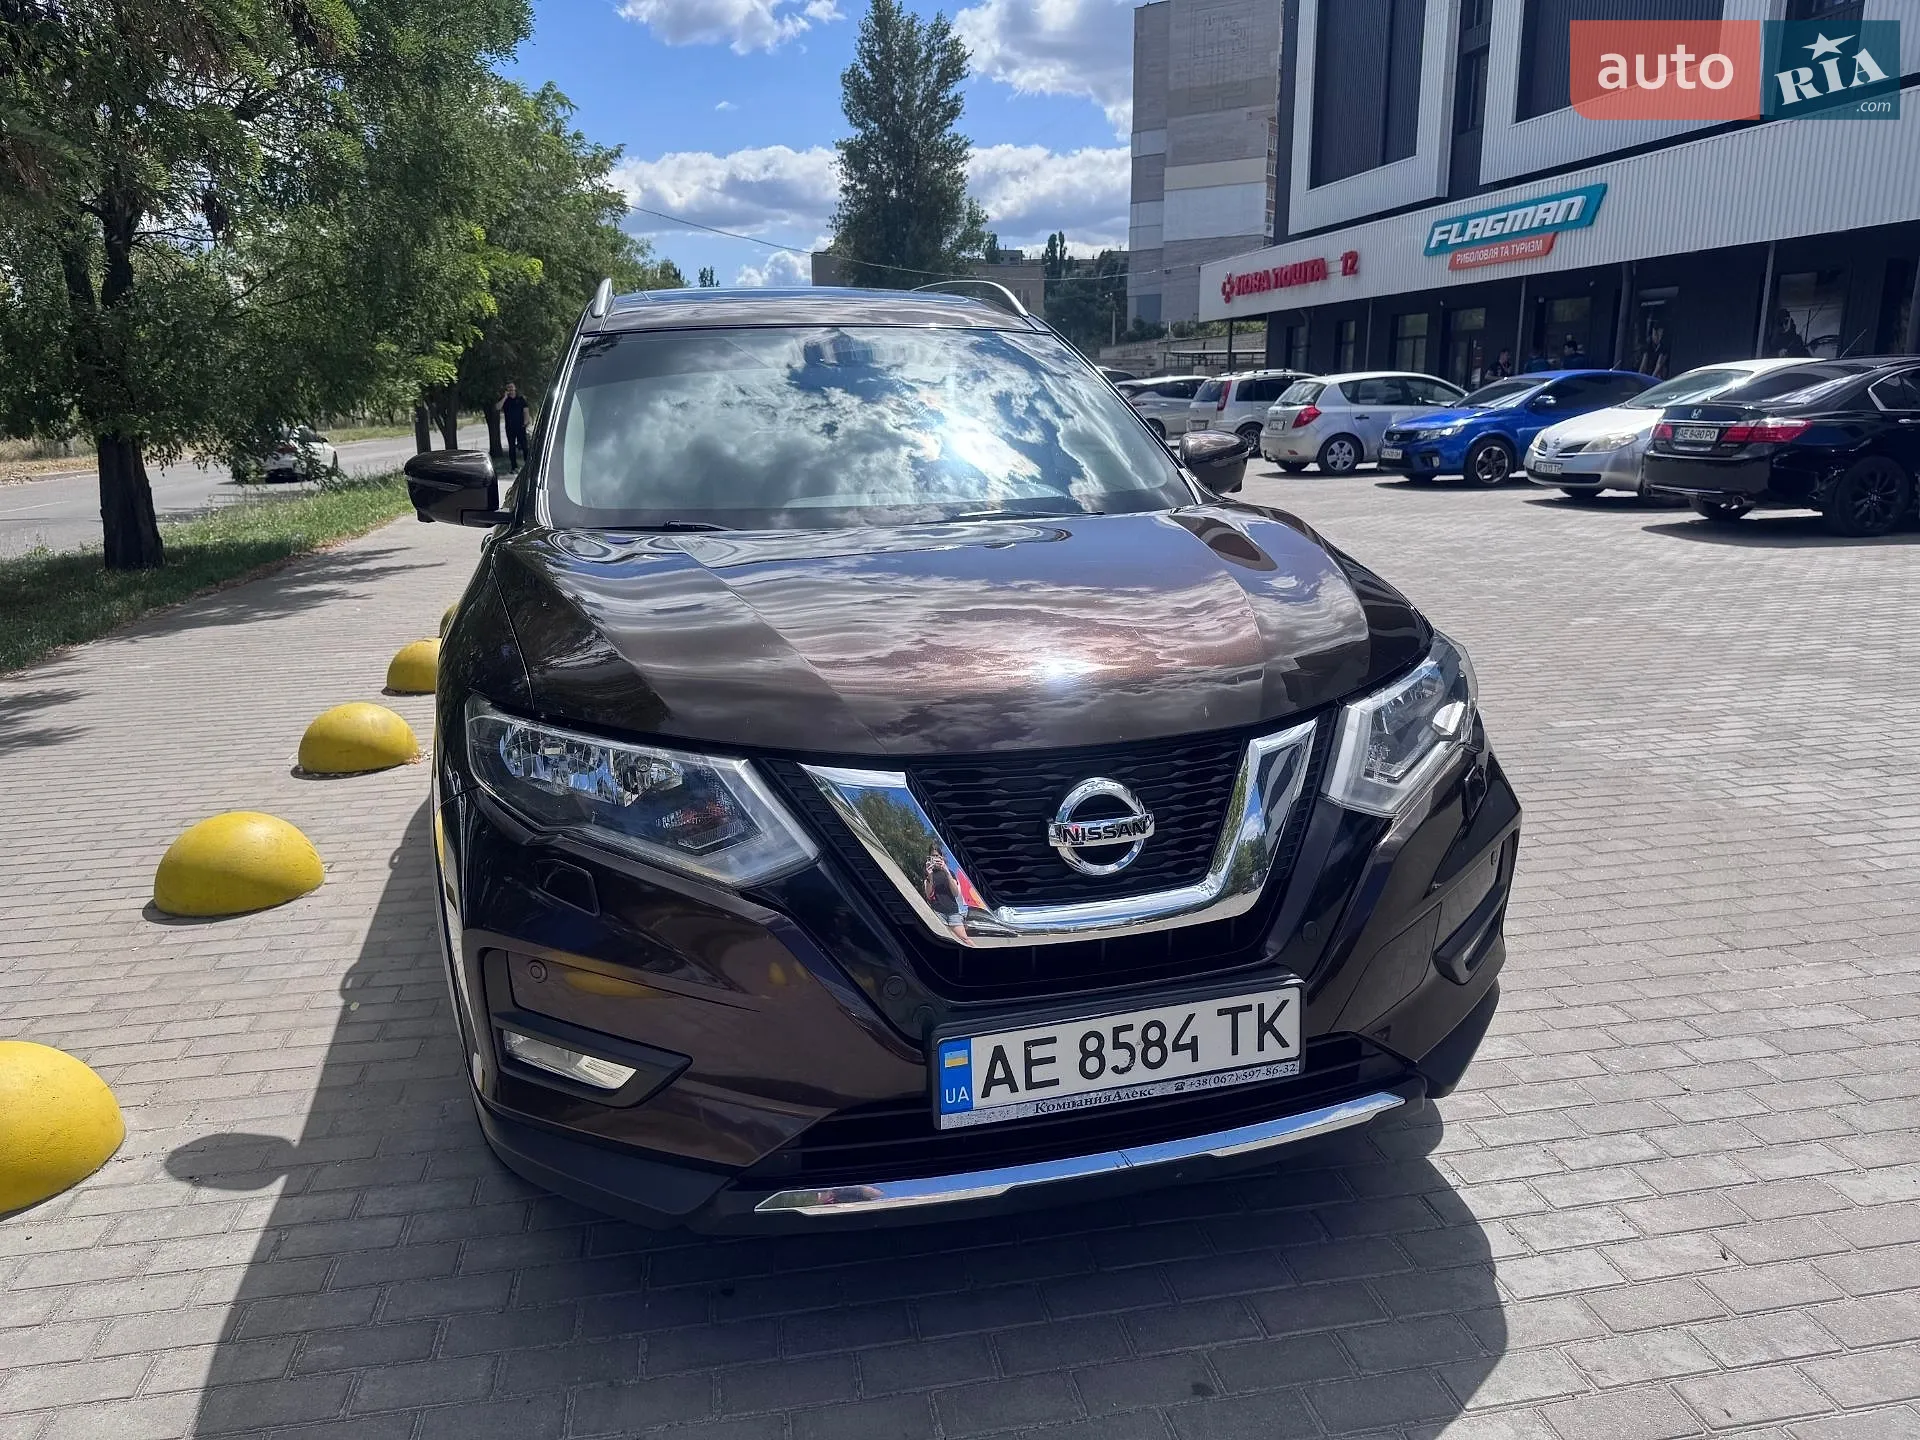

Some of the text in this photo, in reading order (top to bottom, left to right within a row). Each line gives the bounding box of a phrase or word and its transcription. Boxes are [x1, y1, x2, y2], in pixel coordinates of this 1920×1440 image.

[1429, 195, 1587, 249] FLAGMAN
[1341, 250, 1359, 276] 12
[1456, 239, 1543, 264] РИБОЛОВЛЯ ТА ТУРИЗМ
[1062, 820, 1147, 843] NISSAN
[980, 999, 1290, 1099] AE 8584 TK
[945, 1086, 970, 1104] UA
